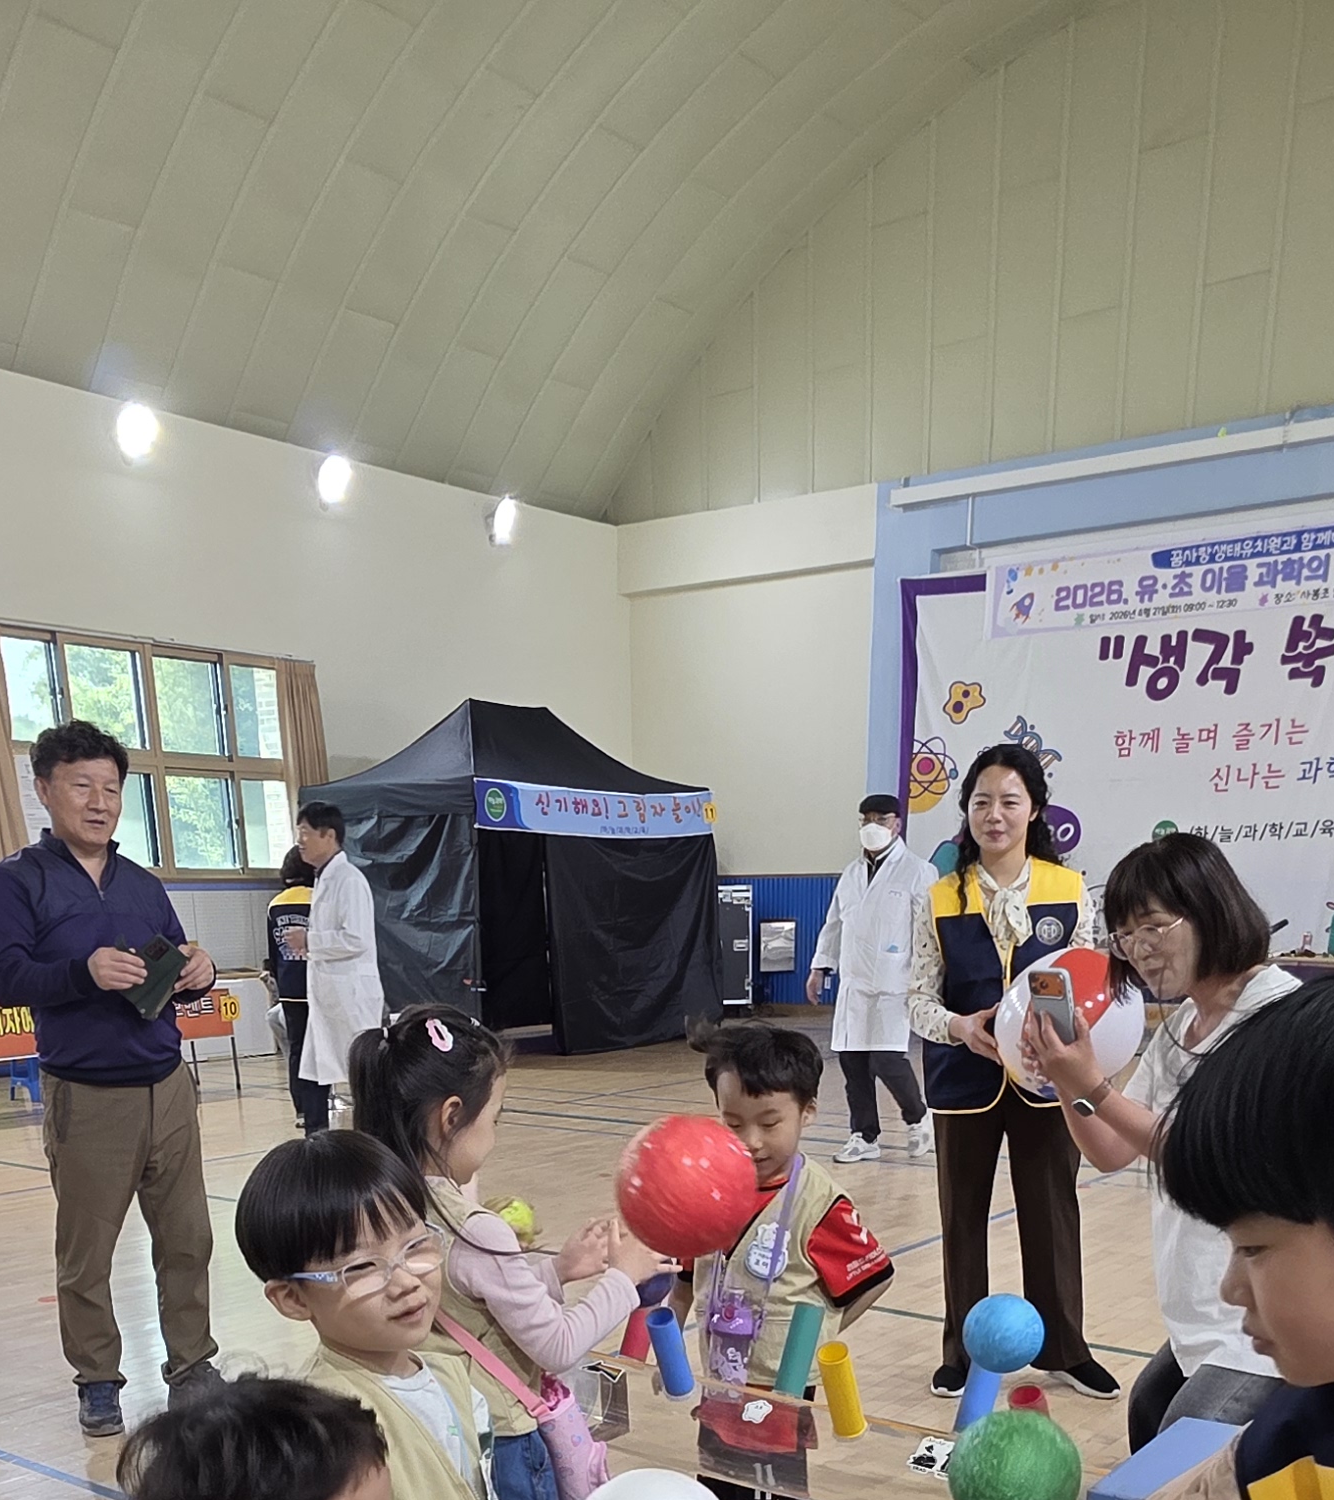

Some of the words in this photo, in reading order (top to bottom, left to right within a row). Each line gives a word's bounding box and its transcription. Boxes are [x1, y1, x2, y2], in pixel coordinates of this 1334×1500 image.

[1169, 534, 1296, 568] 꿈사랑생태유치원과
[1054, 580, 1128, 612] 2026.
[1253, 554, 1331, 589] 과학의
[1099, 627, 1254, 701] "생각
[1113, 727, 1161, 758] 함께
[1171, 723, 1219, 754] 놀며
[1232, 718, 1310, 751] 즐기는
[1208, 760, 1286, 792] 신나는
[535, 792, 609, 819] 신기해요!
[617, 798, 665, 823] 그림자
[705, 807, 715, 819] 11
[223, 1001, 237, 1016] 10
